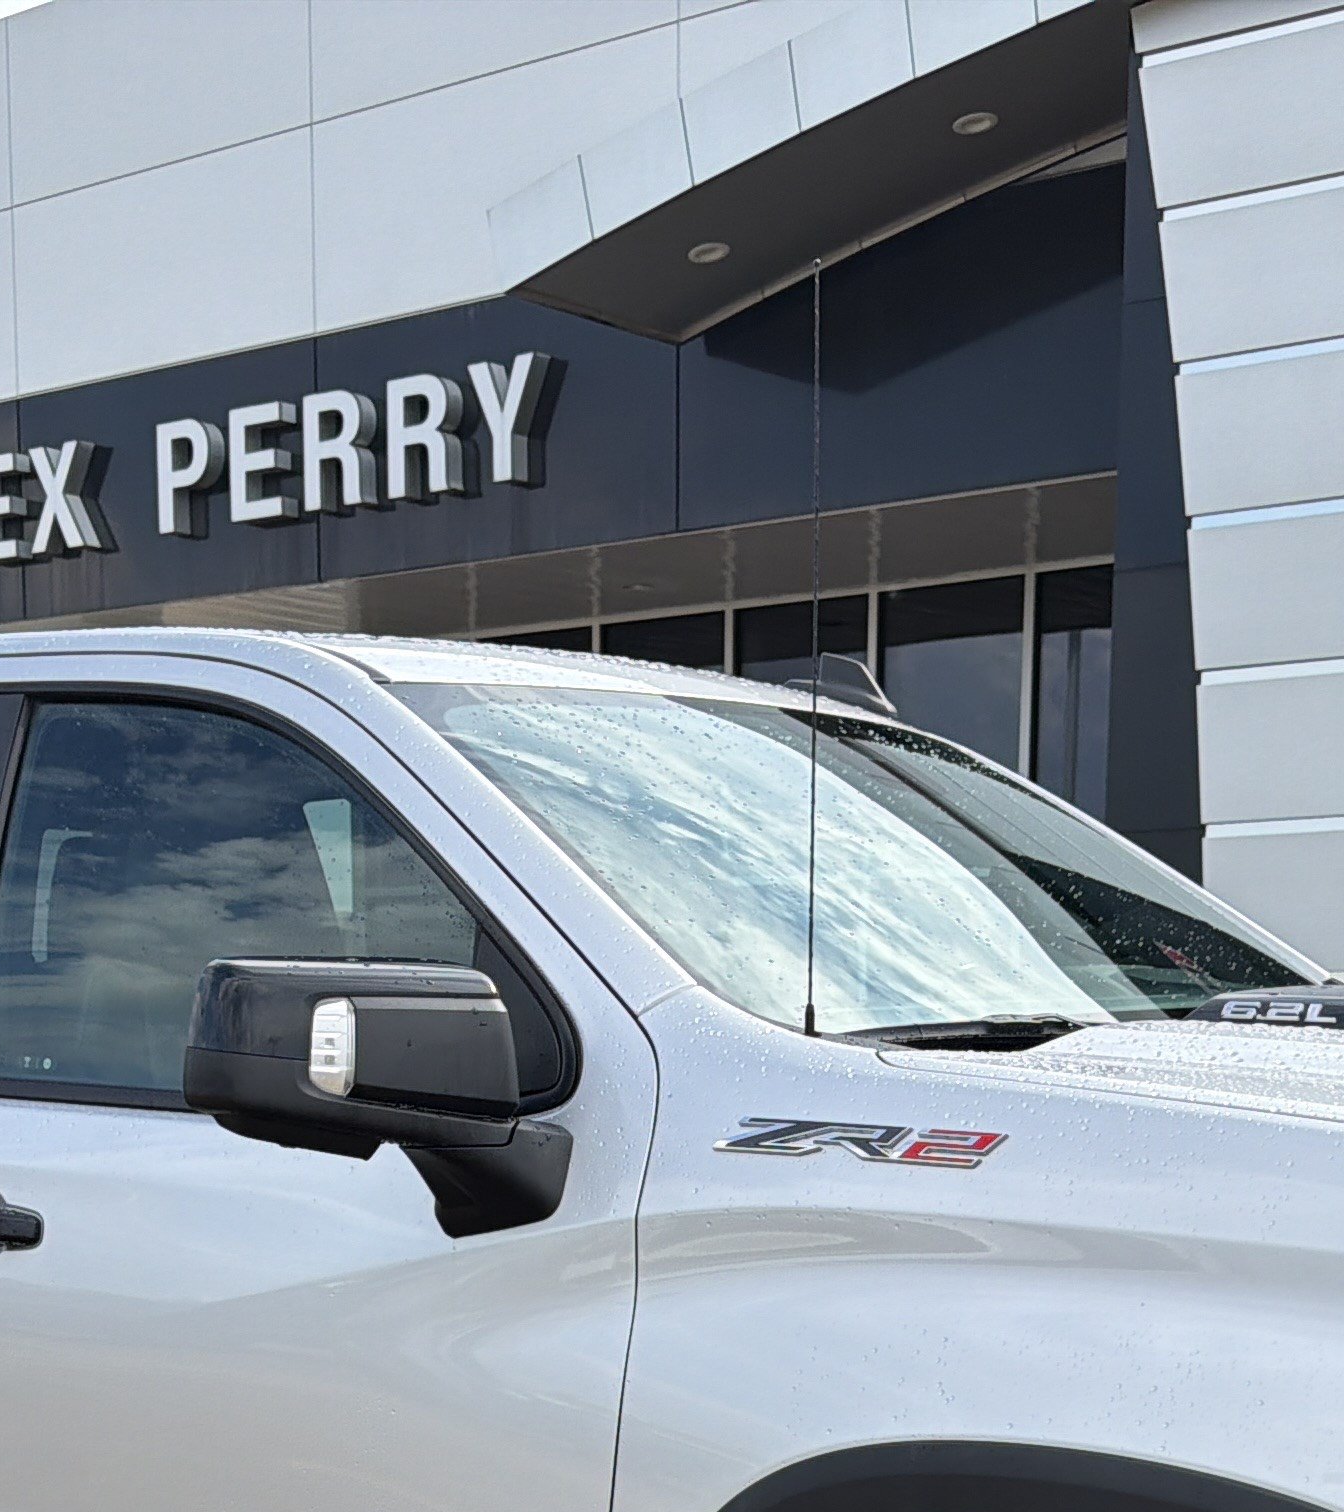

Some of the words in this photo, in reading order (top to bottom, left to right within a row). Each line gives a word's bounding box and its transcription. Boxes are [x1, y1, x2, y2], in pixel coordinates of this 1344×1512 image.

[155, 351, 554, 537] PERRY
[1220, 1001, 1337, 1024] 6.2L
[712, 1115, 1009, 1169] ZR2
